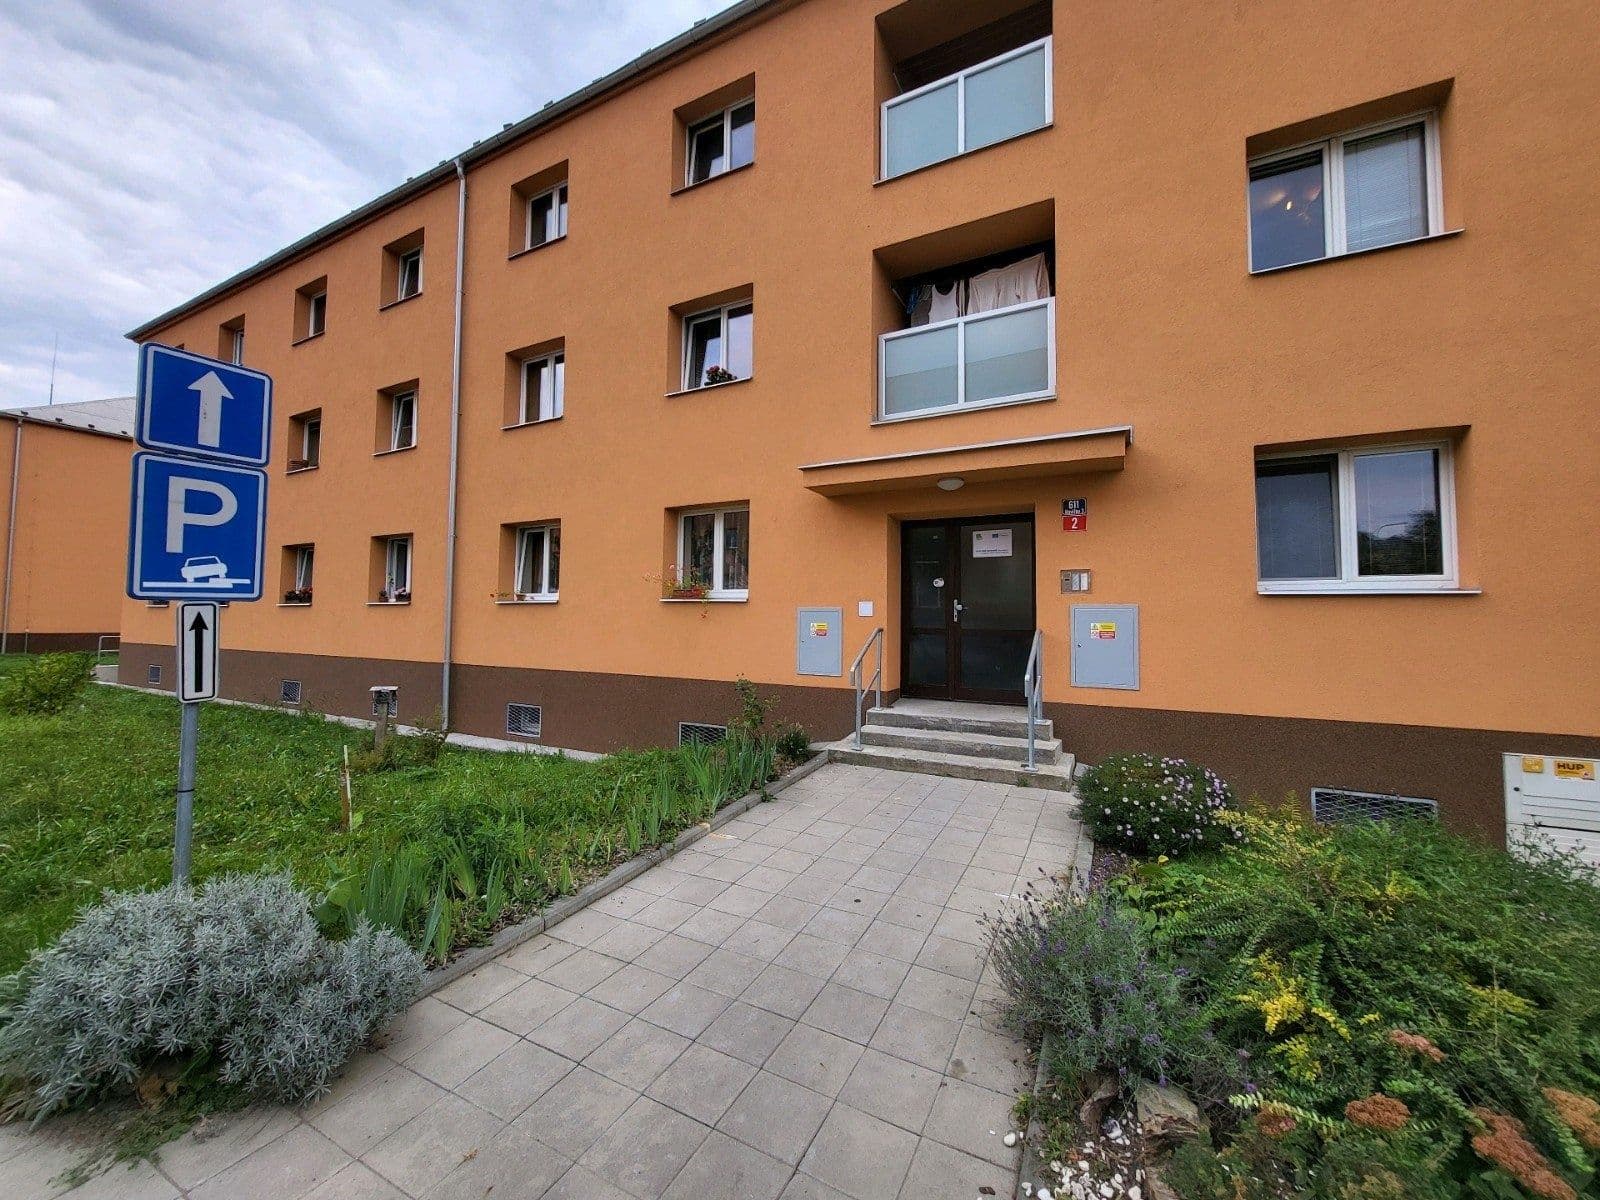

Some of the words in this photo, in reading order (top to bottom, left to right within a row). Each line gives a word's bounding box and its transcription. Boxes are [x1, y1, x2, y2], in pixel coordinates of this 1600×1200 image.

[1068, 500, 1080, 510] 611
[166, 475, 238, 553] P
[1071, 517, 1078, 529] 2
[1557, 762, 1586, 771] HUP
